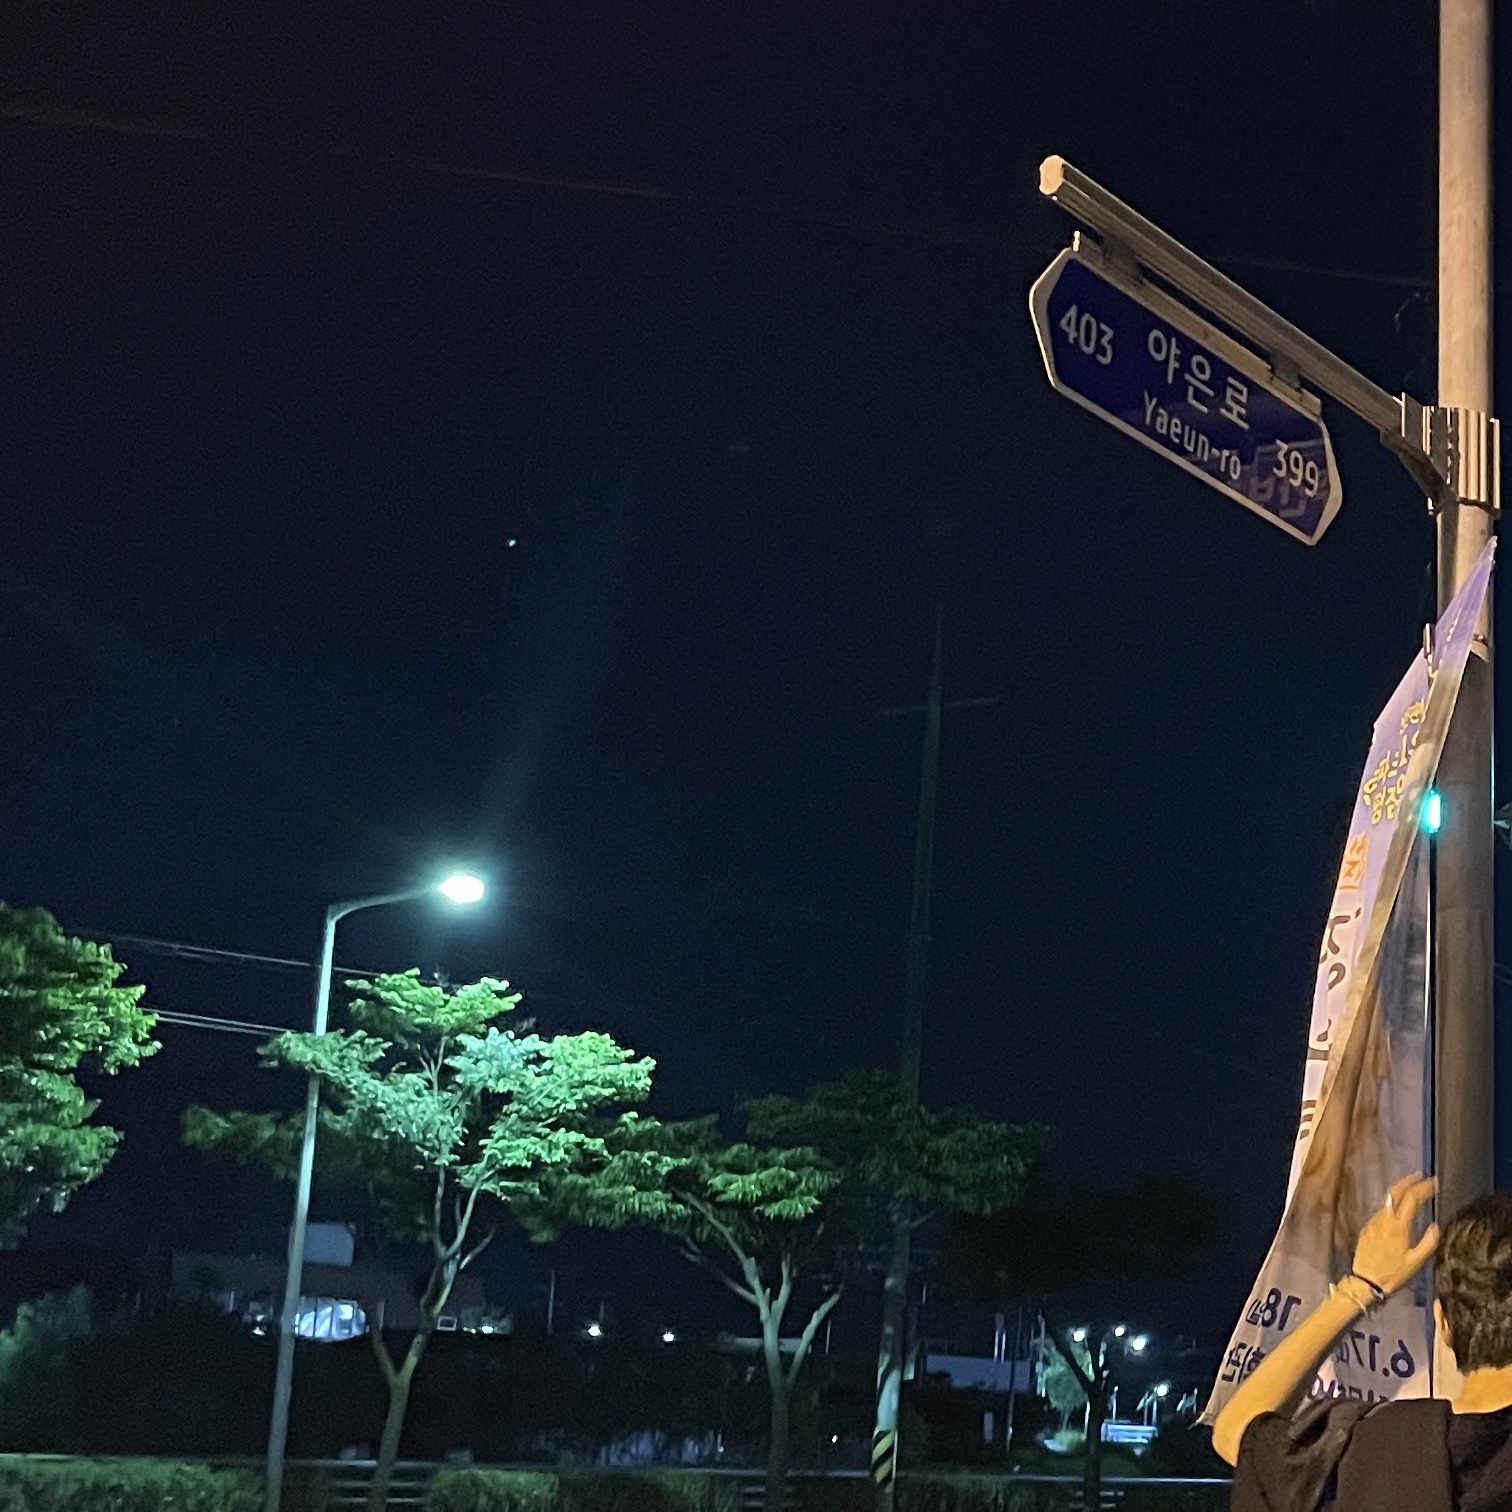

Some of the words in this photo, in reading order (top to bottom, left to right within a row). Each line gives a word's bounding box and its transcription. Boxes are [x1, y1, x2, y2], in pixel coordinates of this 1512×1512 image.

[1059, 304, 1114, 366] 403
[1147, 328, 1250, 431] 야은로
[1143, 389, 1242, 481] Yaeun-ro
[1272, 438, 1320, 498] 399
